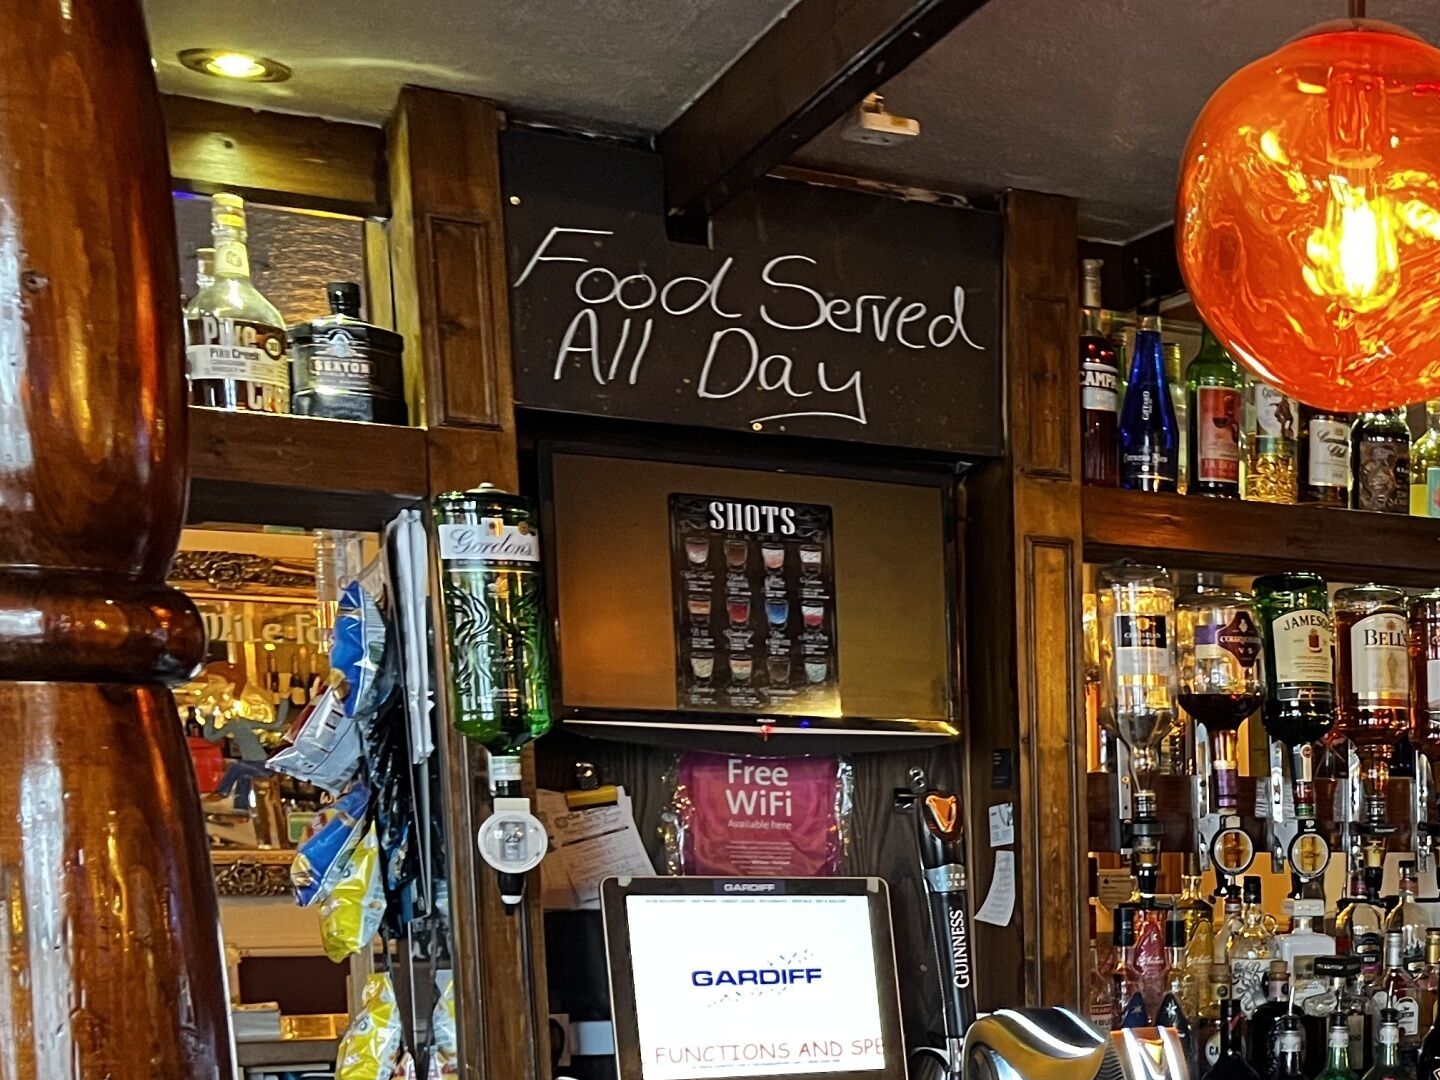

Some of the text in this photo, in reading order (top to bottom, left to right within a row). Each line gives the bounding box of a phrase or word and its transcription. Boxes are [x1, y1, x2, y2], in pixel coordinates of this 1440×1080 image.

[513, 227, 985, 349] Food Served
[554, 308, 867, 424] All Day
[709, 501, 796, 535] SHOTS
[727, 758, 789, 787] Free
[725, 789, 792, 817] WiFi
[728, 818, 792, 830] Available here
[950, 909, 970, 989] GUINNESS
[691, 967, 822, 987] GARDIFF
[655, 1043, 790, 1065] FUNCTIONS
[799, 1040, 843, 1058] AND
